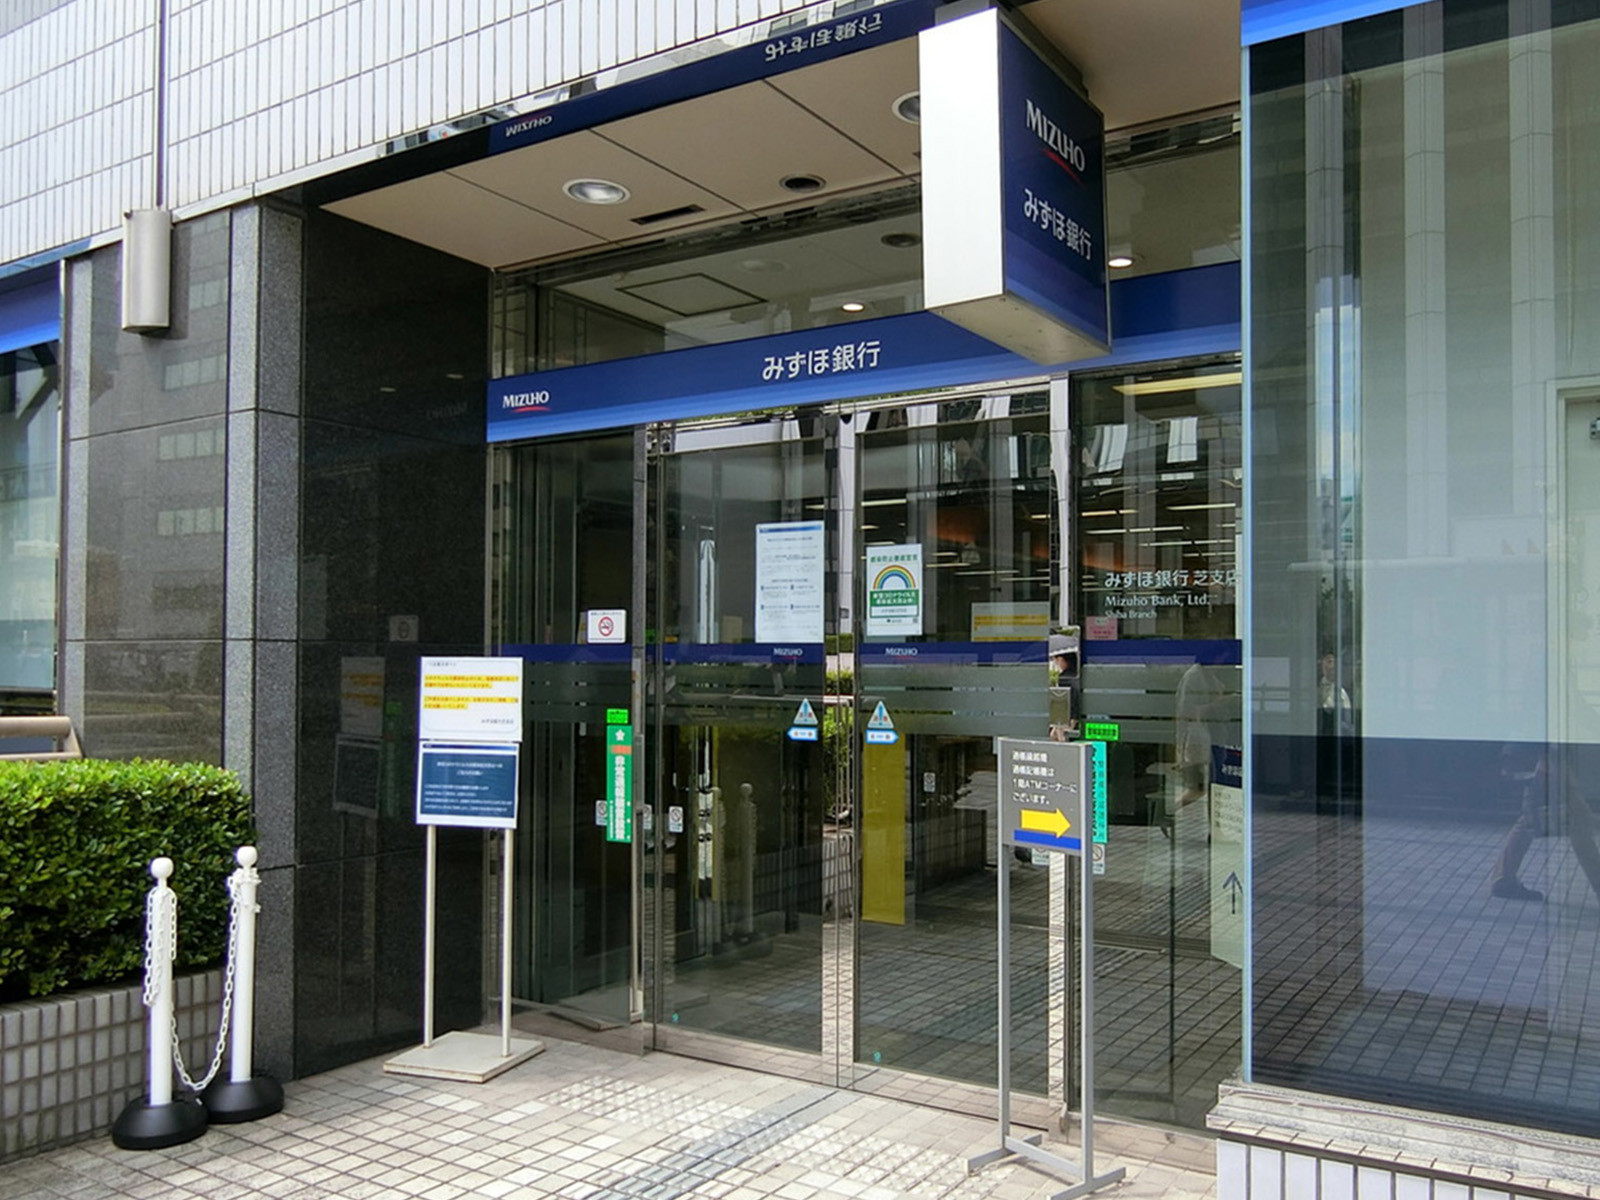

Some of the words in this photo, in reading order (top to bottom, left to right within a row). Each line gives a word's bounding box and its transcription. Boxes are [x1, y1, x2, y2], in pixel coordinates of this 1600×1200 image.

[1026, 99, 1085, 172] MIZUHO
[1024, 188, 1092, 261] みずほ銀行
[762, 340, 880, 381] みずほ銀行
[502, 390, 550, 409] MIZUHO
[1104, 569, 1189, 588] みずほ銀行
[1193, 569, 1239, 587] 芝支店
[1104, 595, 1148, 606] Mizuho
[1151, 594, 1184, 608] Bank,
[1187, 593, 1210, 606] Ltd.
[1129, 609, 1157, 619] Branch
[773, 648, 803, 656] MIZUHO
[885, 647, 918, 656] MIZUHO
